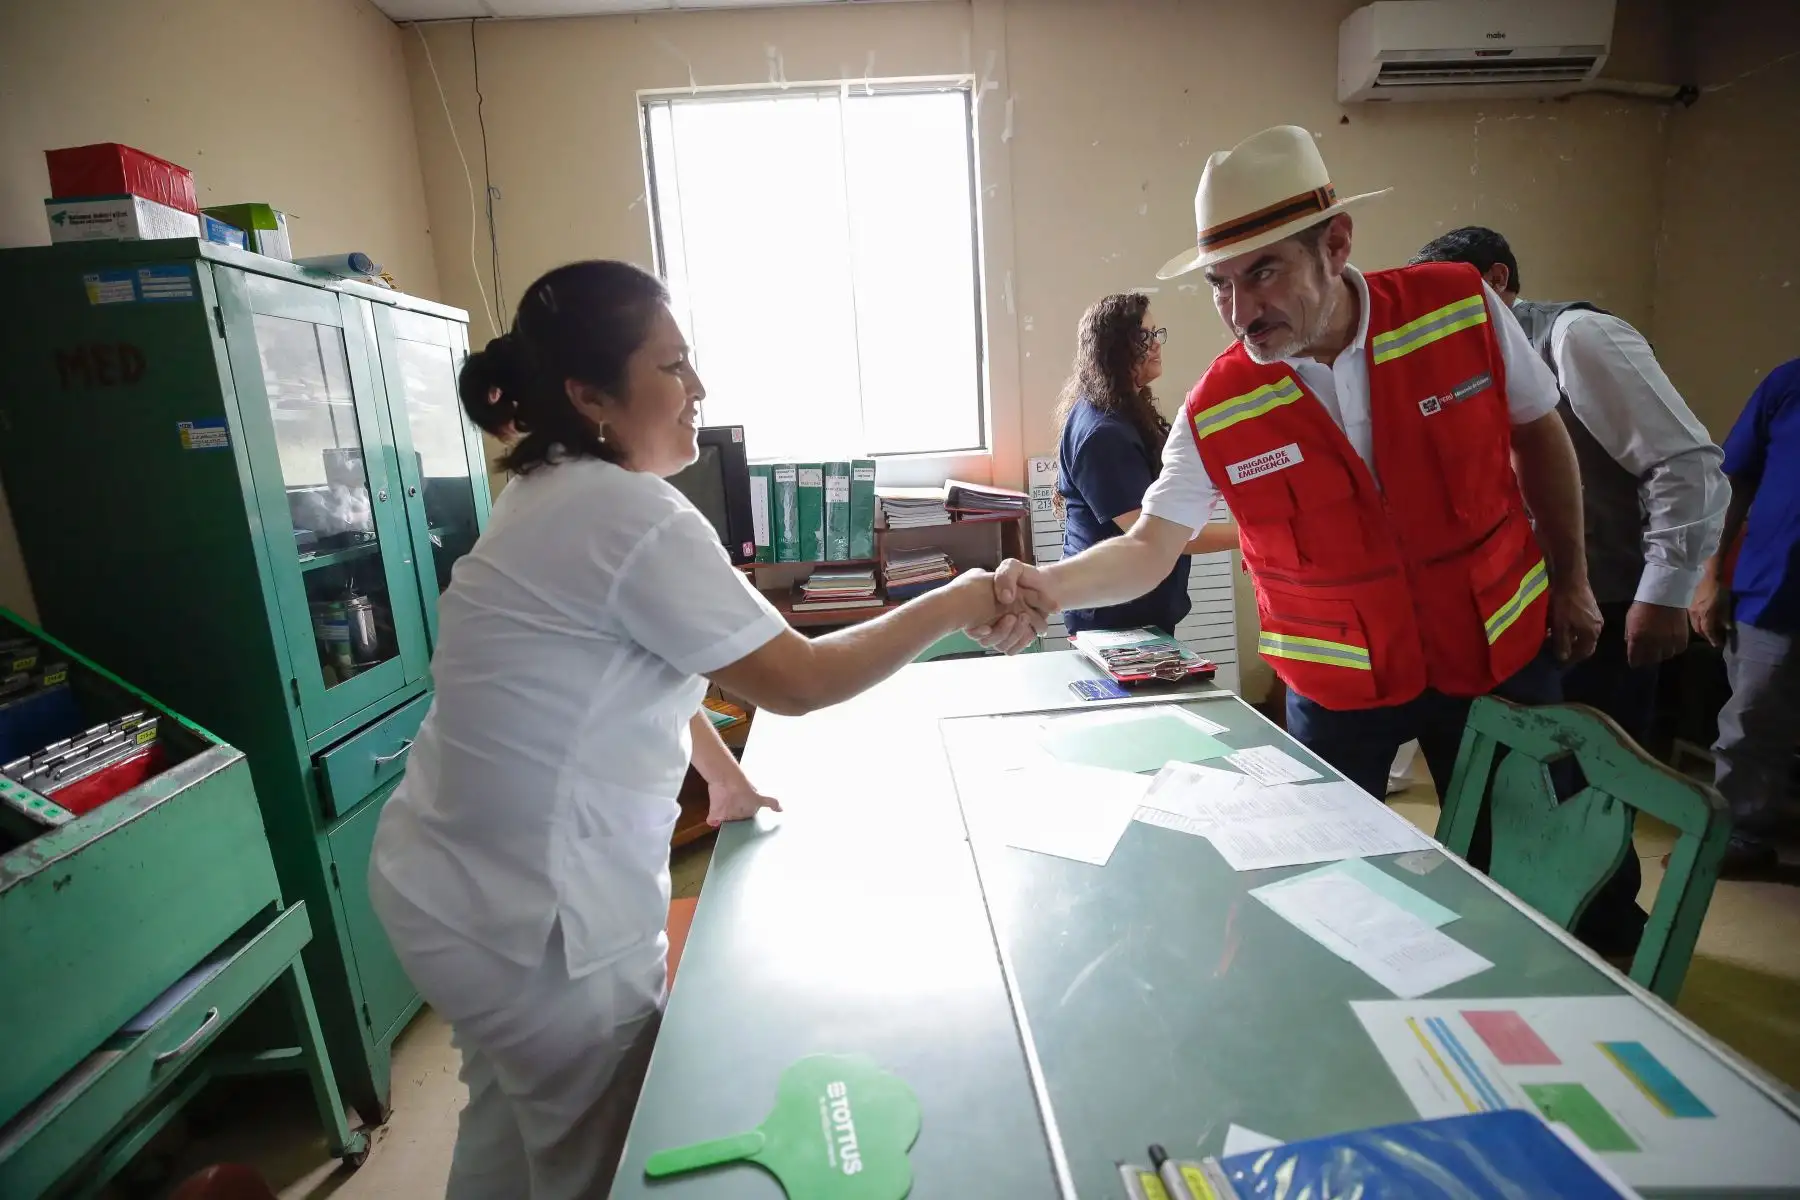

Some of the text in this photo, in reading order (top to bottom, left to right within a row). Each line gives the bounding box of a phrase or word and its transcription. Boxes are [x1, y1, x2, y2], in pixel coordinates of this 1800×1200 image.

[1486, 31, 1506, 39] mabe
[55, 344, 148, 393] MED
[1237, 450, 1287, 472] BRIGADA DE
[1238, 456, 1291, 479] EMERGENCIA
[830, 1096, 862, 1175] TOTTUS
